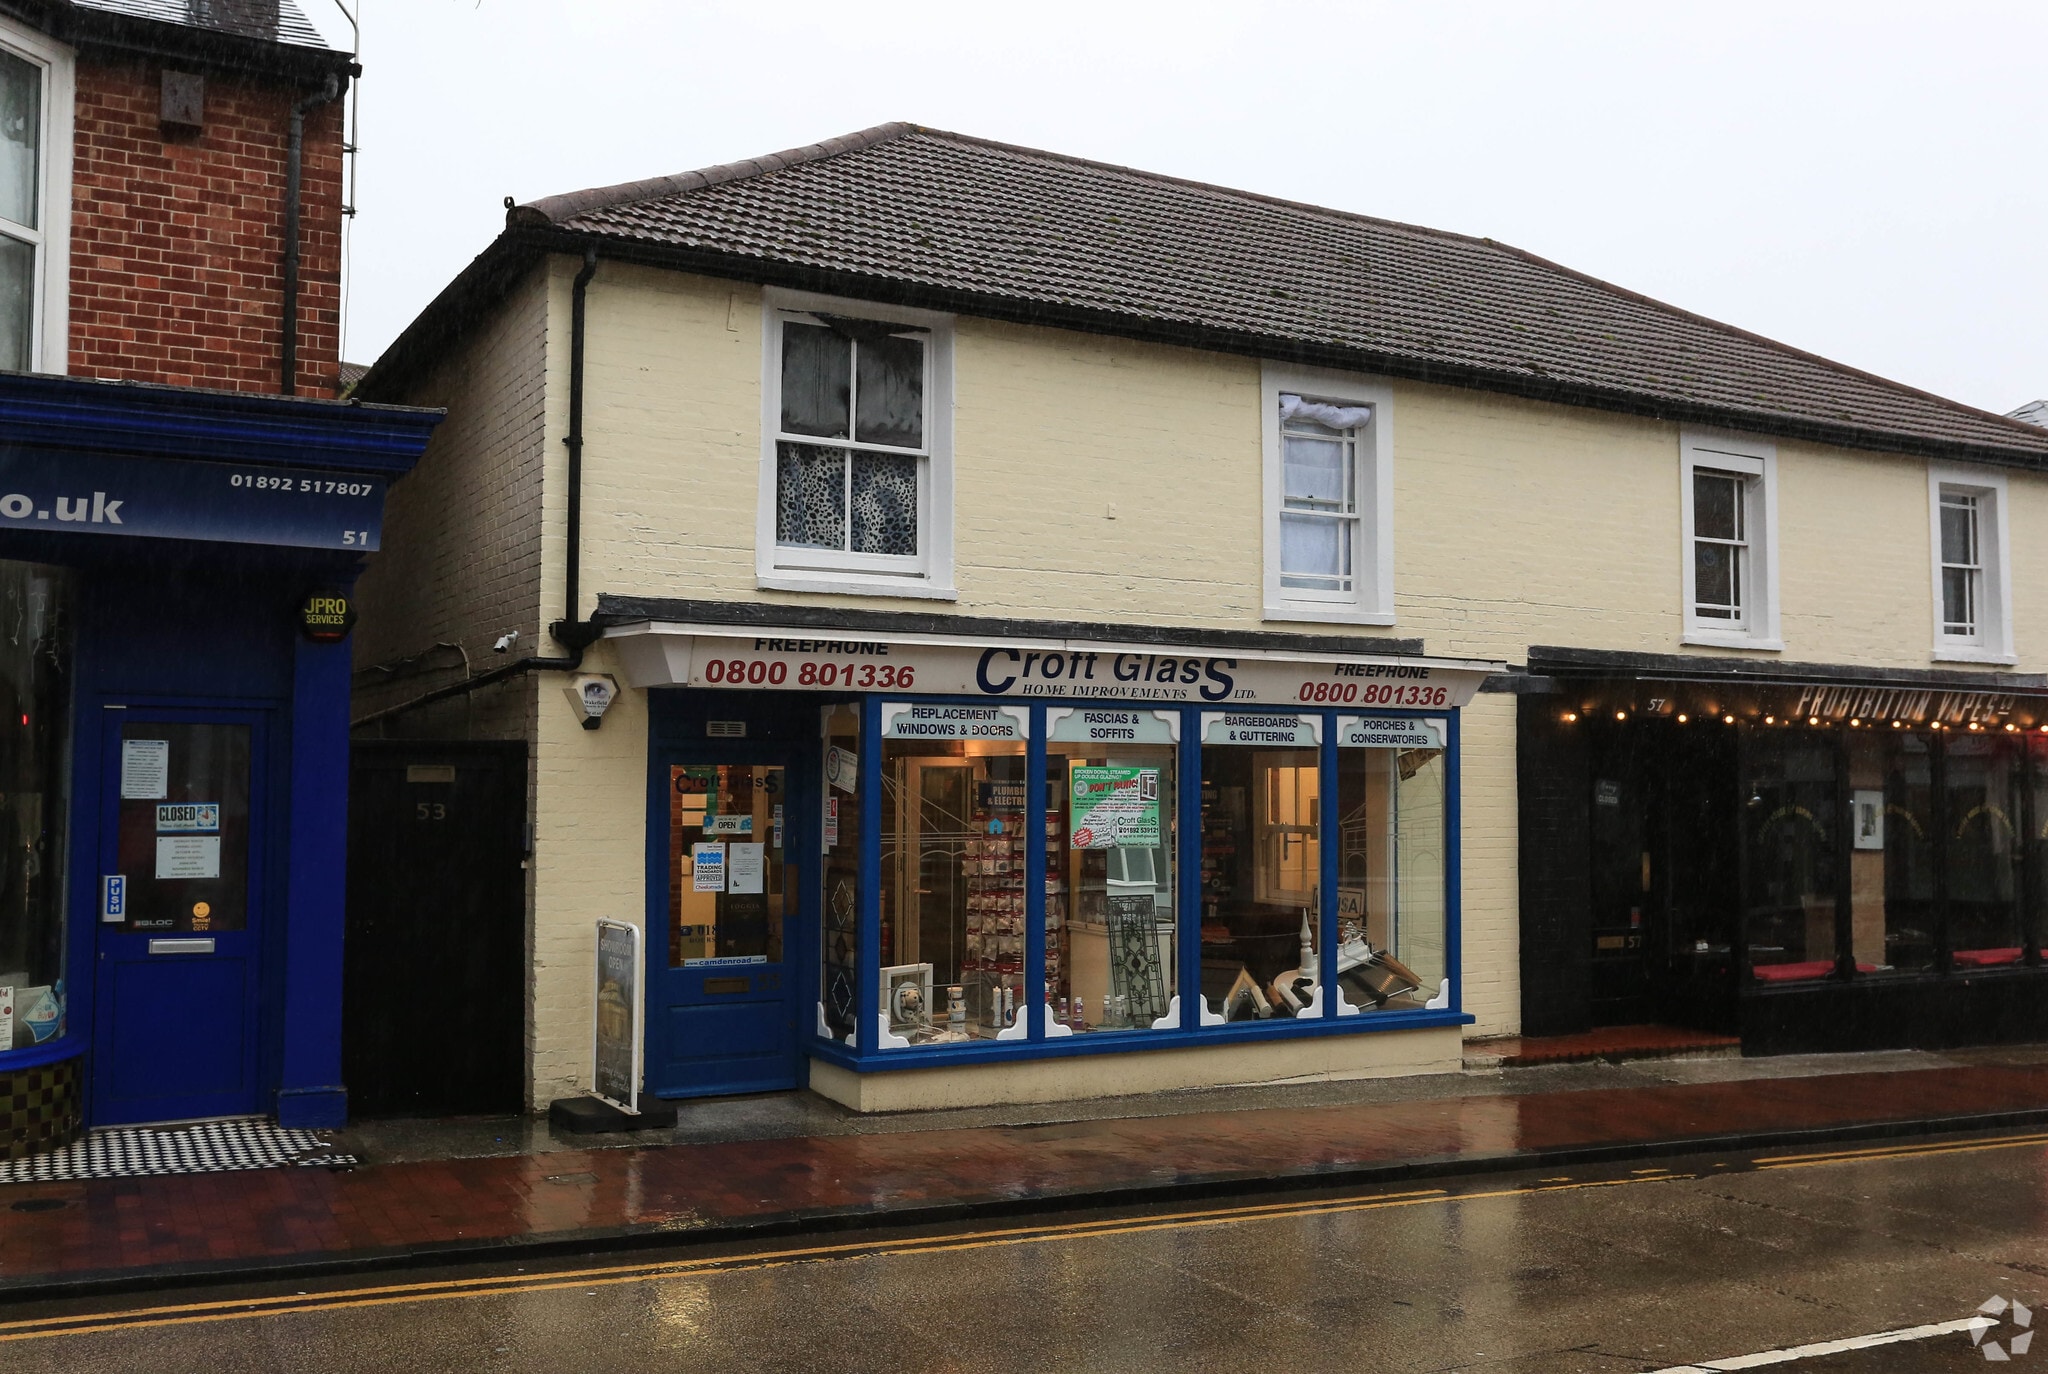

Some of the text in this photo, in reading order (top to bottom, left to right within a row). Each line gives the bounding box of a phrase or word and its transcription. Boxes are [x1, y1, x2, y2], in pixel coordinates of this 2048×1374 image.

[230, 474, 373, 497] 01892 517807
[342, 530, 369, 546] 51
[304, 597, 347, 615] JPRO
[305, 614, 345, 625] SERVICES
[754, 637, 889, 655] FREEPHONE
[705, 659, 915, 689] 0800 801336
[976, 647, 1098, 695] Croft
[1335, 663, 1431, 679] FREEPHONE
[1022, 683, 1066, 697] HOME
[1072, 685, 1188, 700] IMPROVEMENTS
[1299, 682, 1447, 706] 0800 801336
[1648, 698, 1666, 712] 57
[1795, 686, 1932, 723] PROHIBITION
[1937, 691, 1998, 723] VAPES
[912, 707, 998, 721] REPLACEMENT
[1084, 713, 1140, 724] FASCIAS &
[896, 723, 1013, 737] WINDOWS & DOORS
[1225, 716, 1298, 729] BARGEBOARDS
[1363, 721, 1416, 733] PORCHES &
[1090, 728, 1135, 739] SOFFITS
[1229, 730, 1296, 743] & GUTTERING
[1350, 733, 1428, 745] CONSERVATORIES
[676, 774, 721, 794] Croft
[1089, 782, 1113, 793] DON'T
[158, 806, 196, 822] CLOSED
[416, 803, 446, 820] 53
[717, 821, 737, 829] OPEN
[1117, 816, 1136, 825] Croft
[110, 878, 121, 913] PUSH
[600, 939, 633, 956] SHOWROOM
[1628, 935, 1642, 950] 57
[608, 955, 624, 970] OPEN
